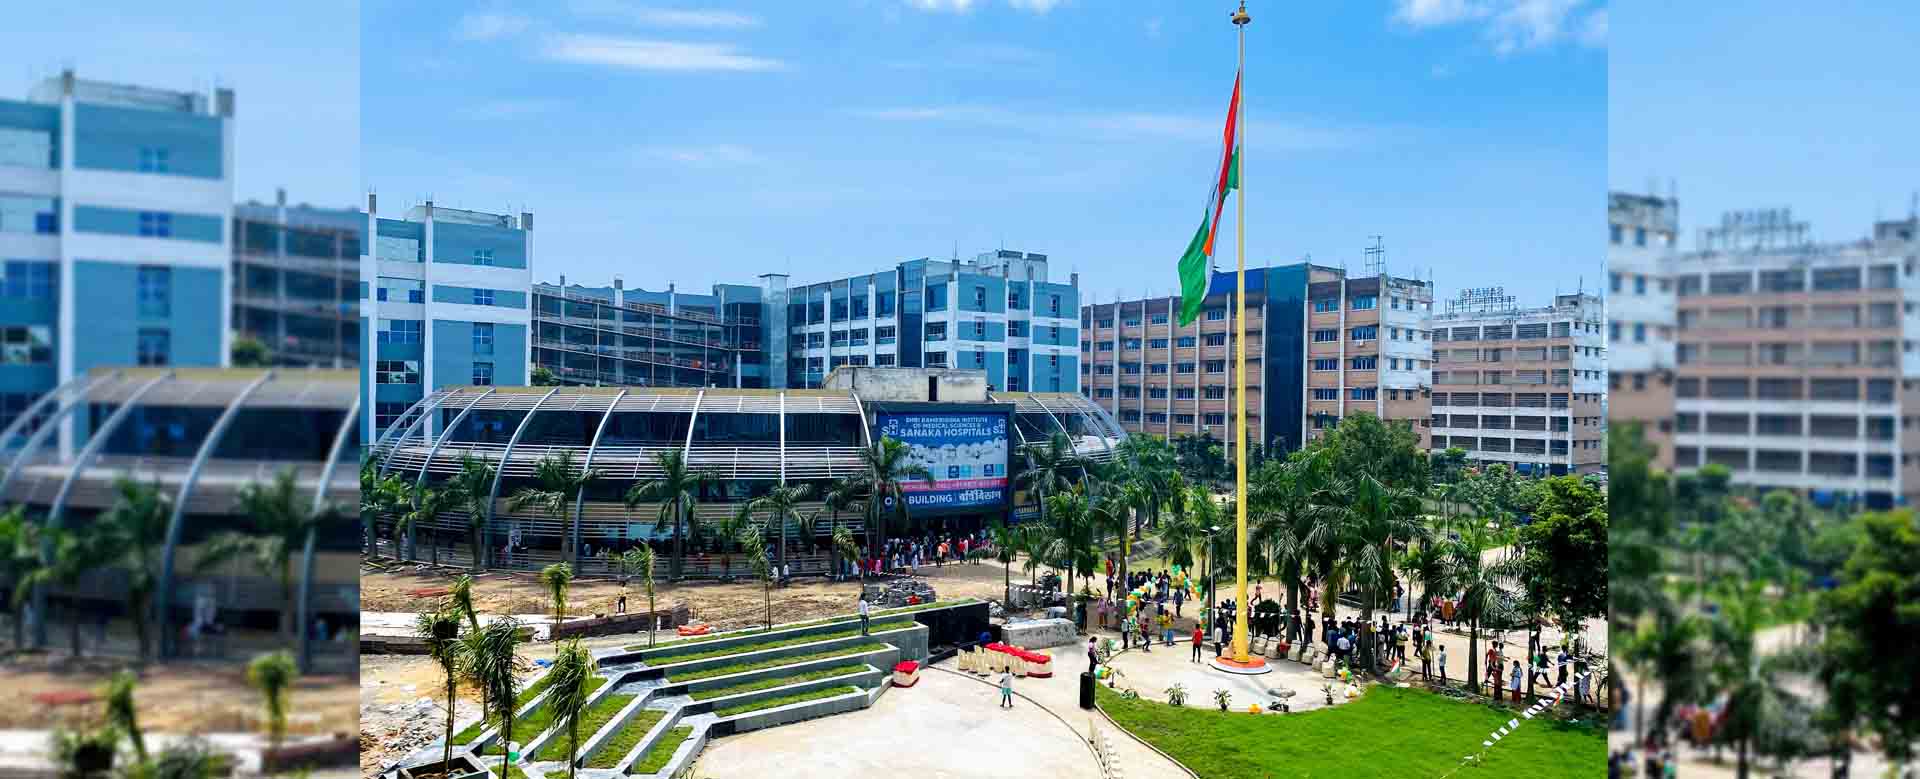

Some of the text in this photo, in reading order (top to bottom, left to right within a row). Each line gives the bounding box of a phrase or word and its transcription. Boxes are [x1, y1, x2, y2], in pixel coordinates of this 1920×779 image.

[900, 427, 992, 438] SANAKA HOSPITALS
[908, 494, 953, 505] BUILDING
